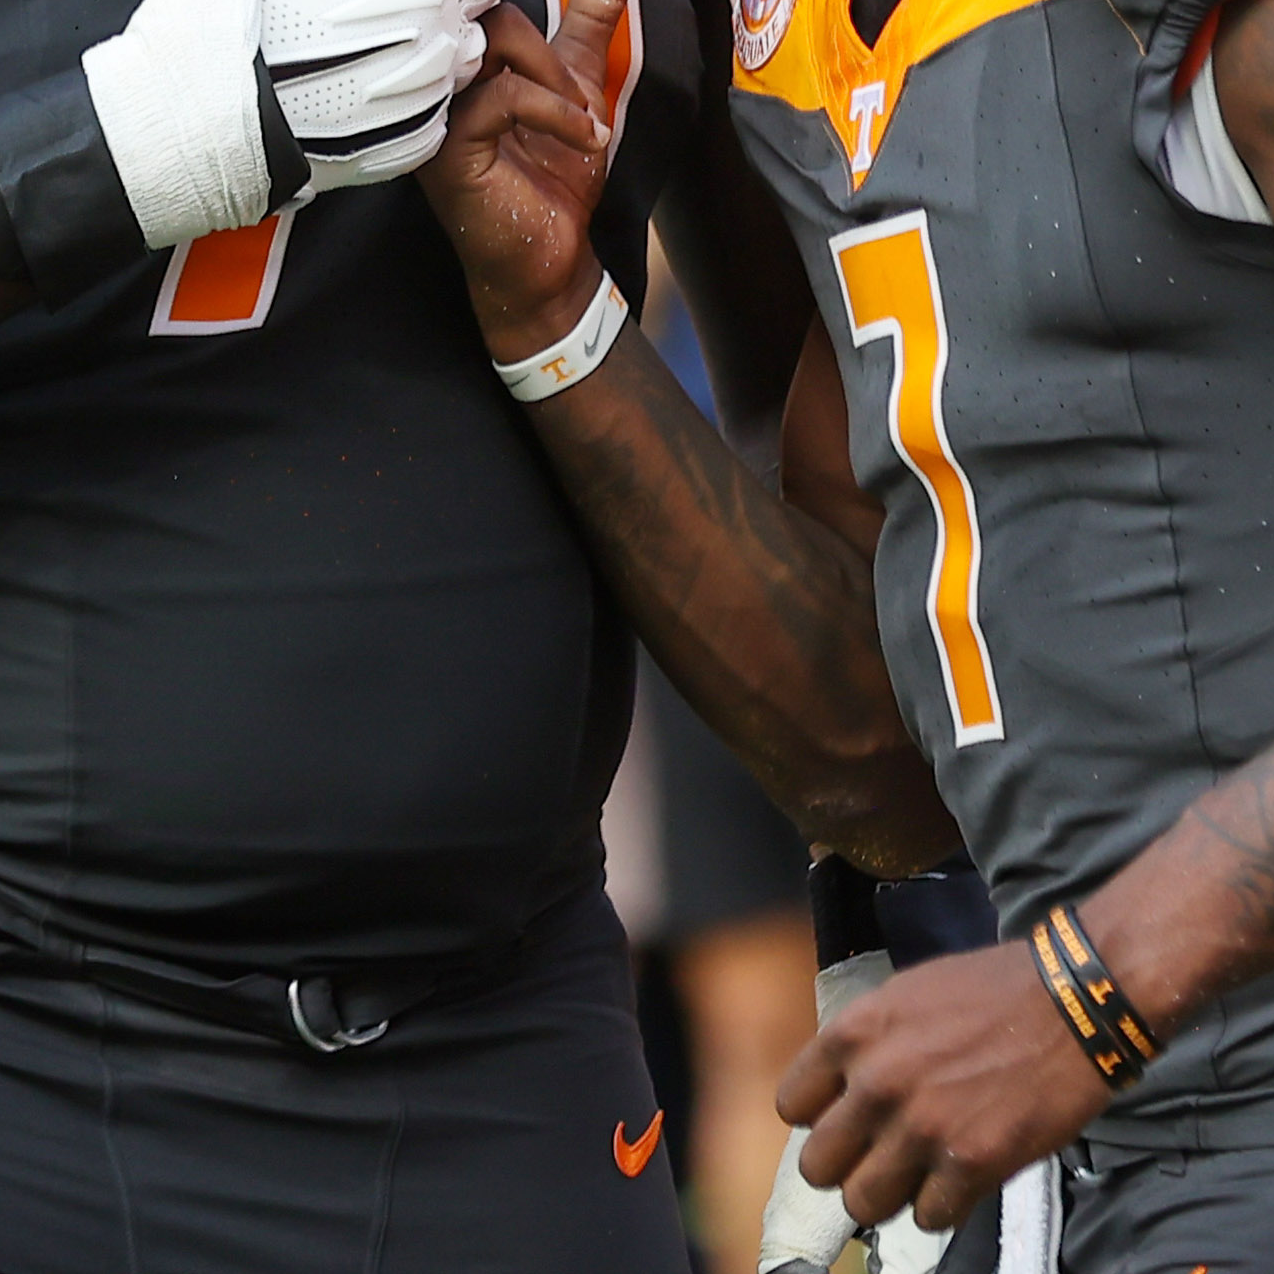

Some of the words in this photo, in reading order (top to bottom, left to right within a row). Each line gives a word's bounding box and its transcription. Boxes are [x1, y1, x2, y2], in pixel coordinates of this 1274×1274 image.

[850, 80, 886, 174] T
[541, 356, 568, 383] T
[828, 208, 1006, 750] 7
